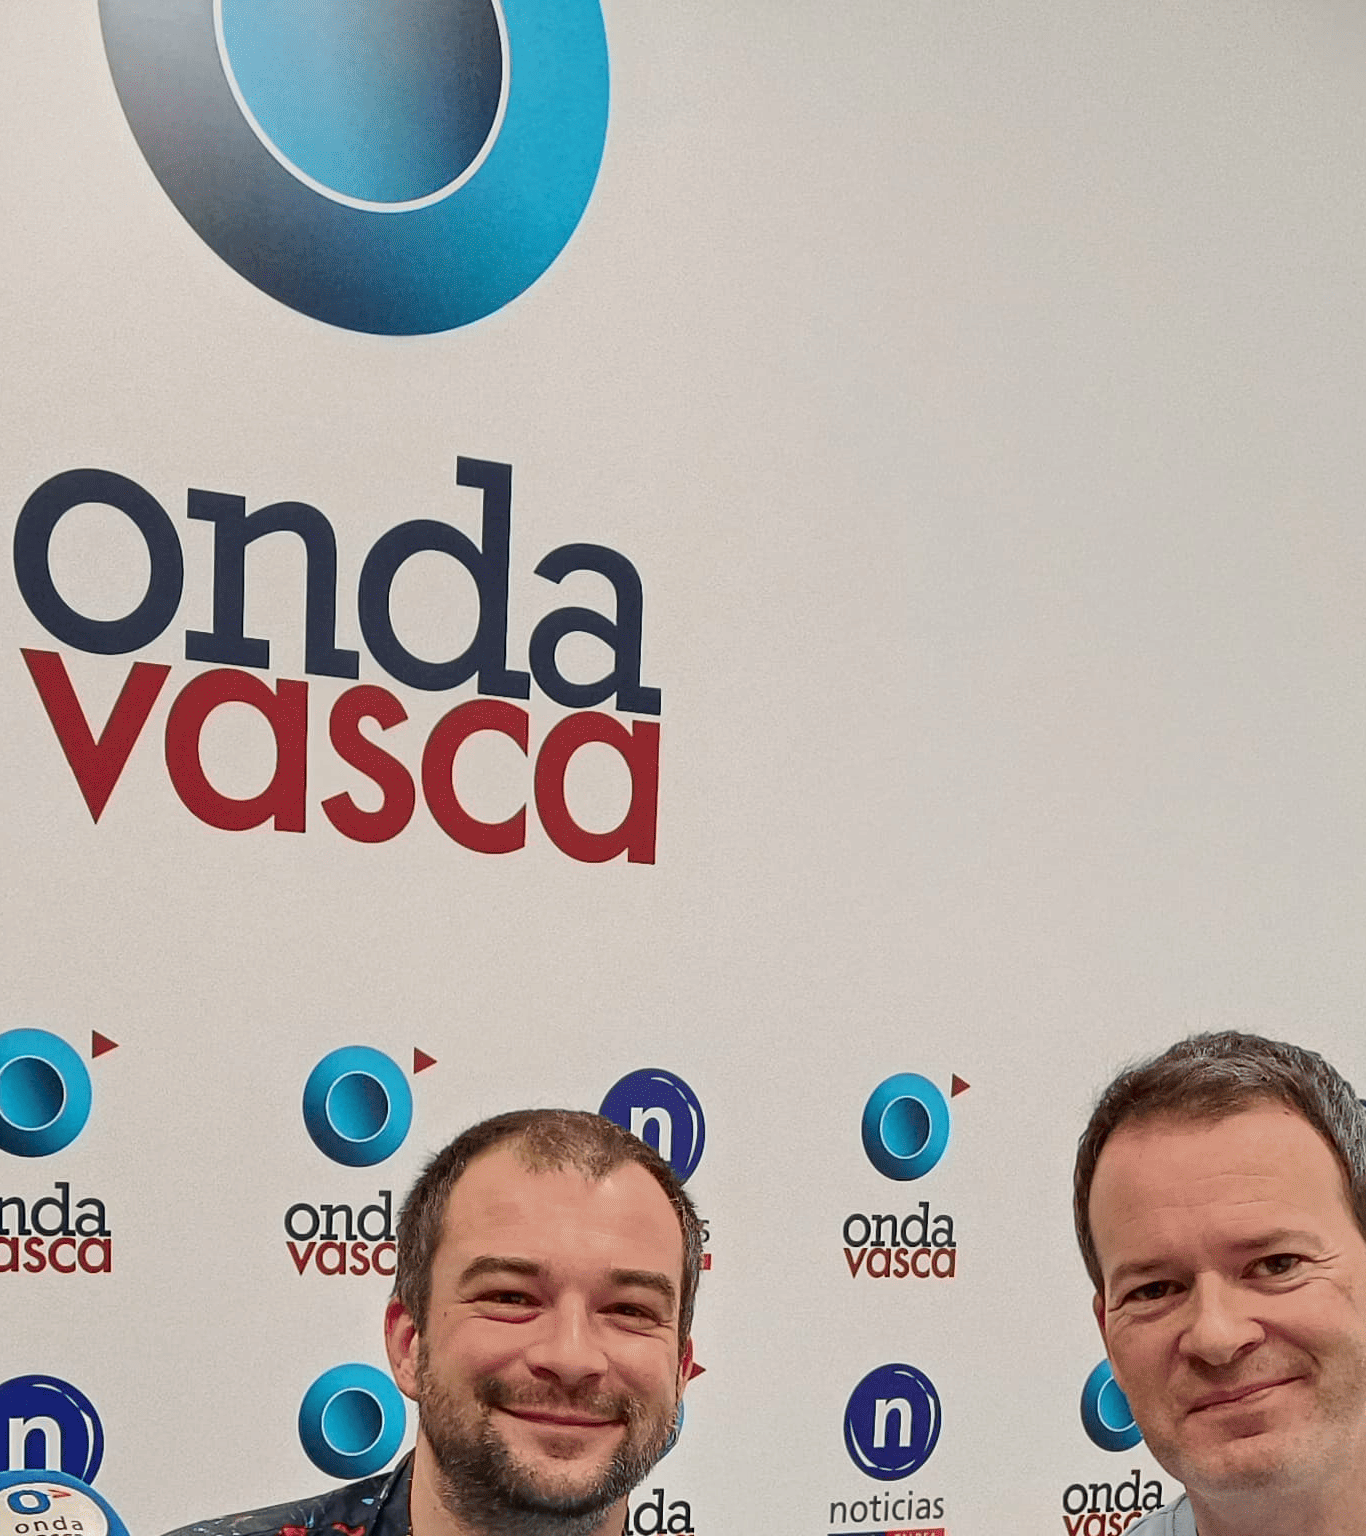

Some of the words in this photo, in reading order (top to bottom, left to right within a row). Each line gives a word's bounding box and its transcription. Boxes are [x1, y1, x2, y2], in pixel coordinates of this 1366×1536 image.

[13, 456, 662, 715] onda
[20, 648, 662, 865] vasca
[285, 1191, 396, 1241] ond
[843, 1202, 956, 1247] onda
[286, 1241, 396, 1276] vasc
[844, 1247, 956, 1278] vasca
[9, 1416, 62, 1471] n
[874, 1398, 911, 1447] n
[624, 1488, 694, 1536] da
[831, 1491, 943, 1523] noticias
[1063, 1470, 1164, 1515] onda
[15, 1515, 84, 1534] onda
